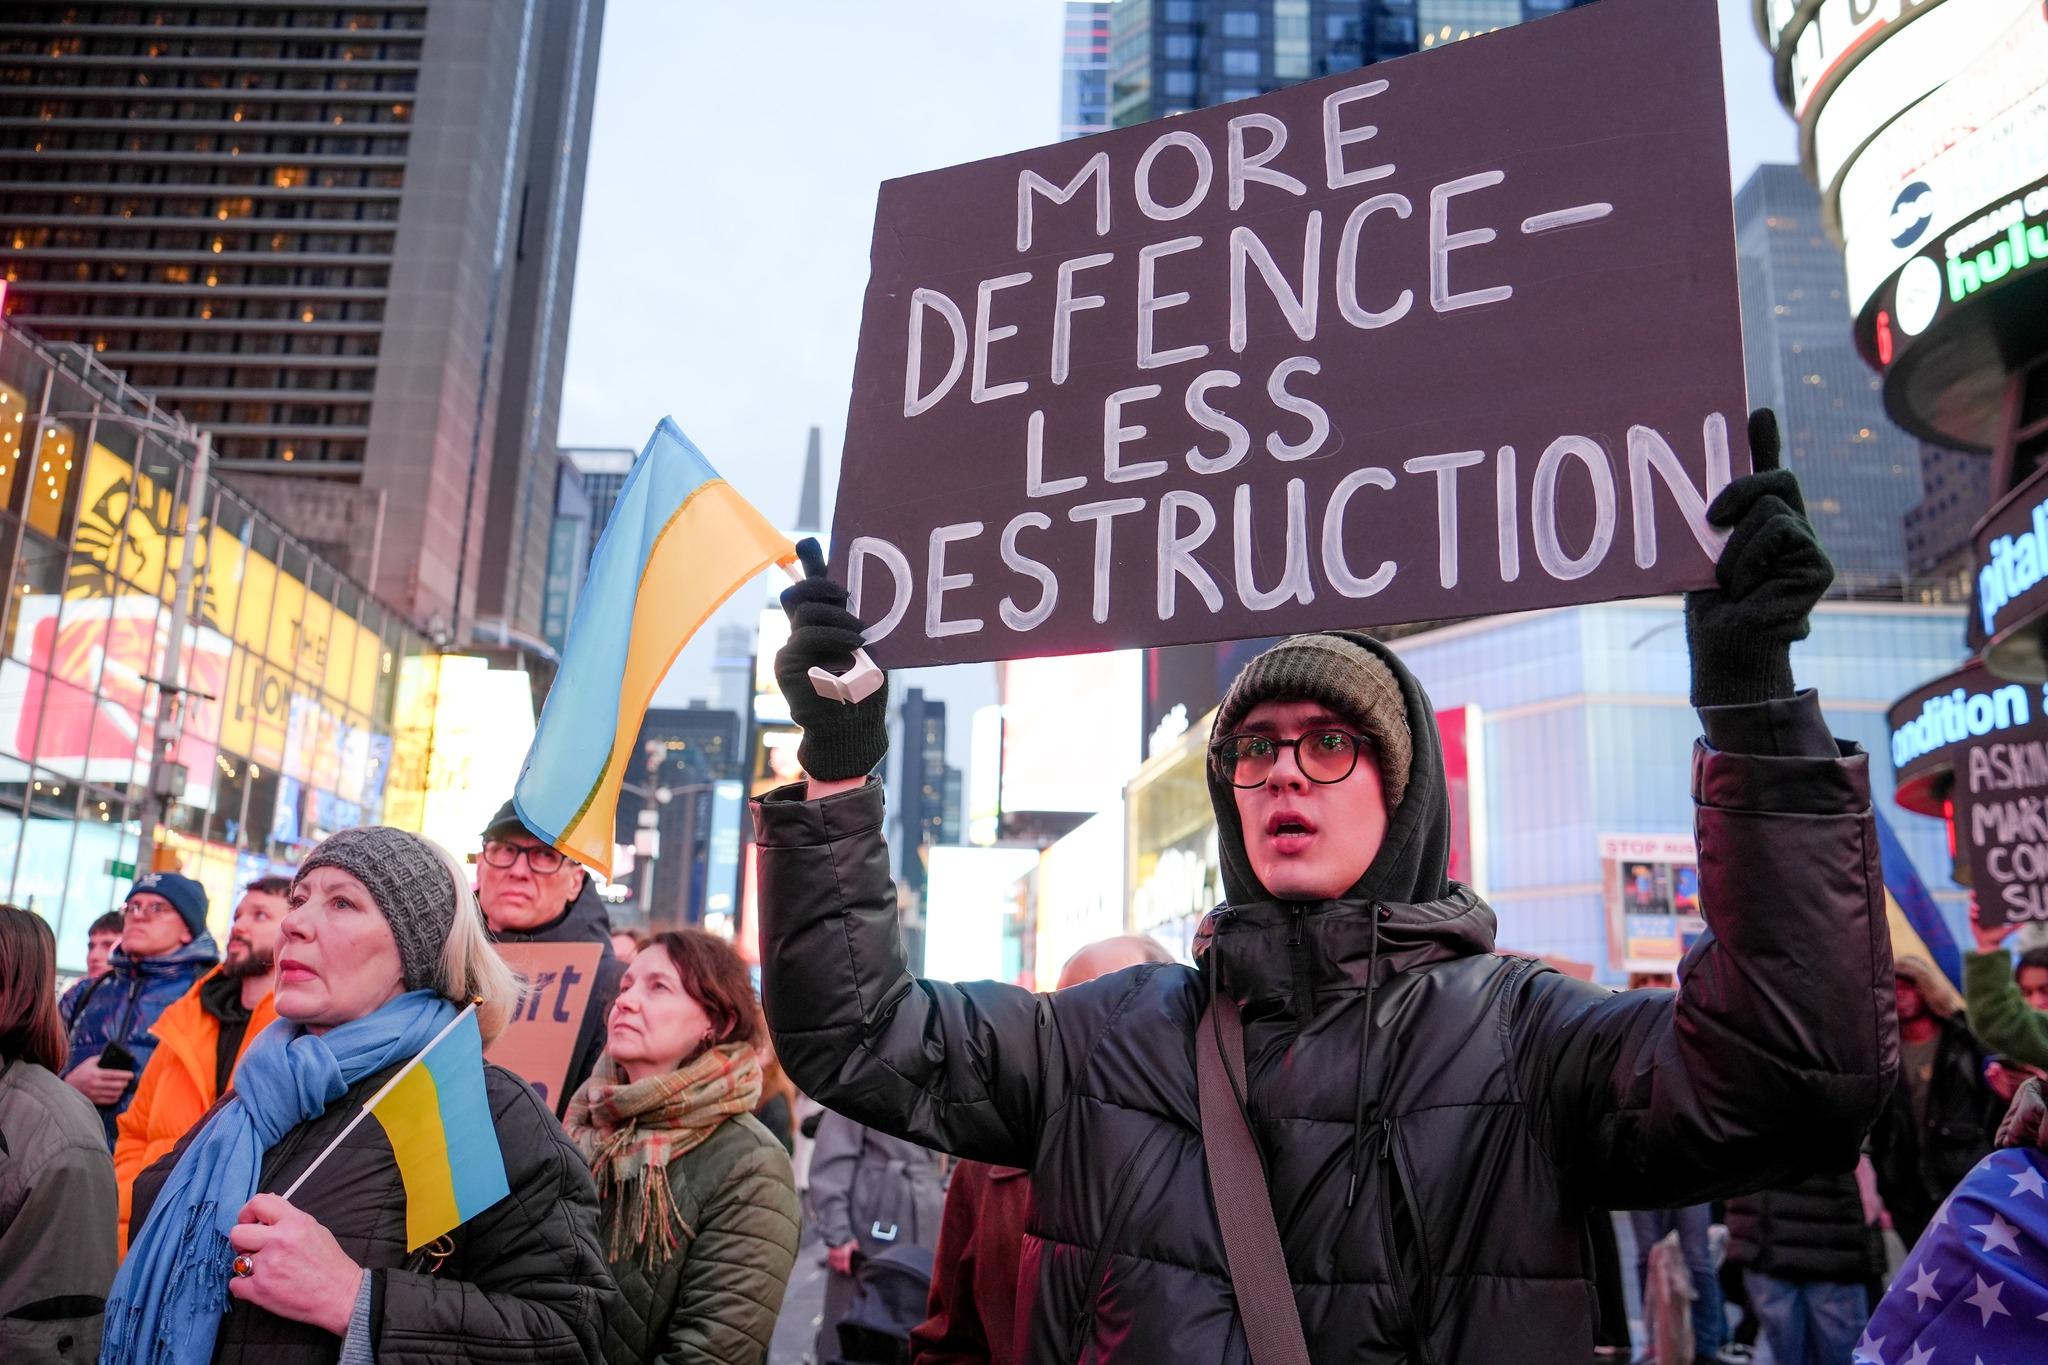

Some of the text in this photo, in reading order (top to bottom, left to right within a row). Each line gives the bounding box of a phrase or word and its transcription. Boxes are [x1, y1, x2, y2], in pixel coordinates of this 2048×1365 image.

[1016, 79, 1396, 252] MORE
[1026, 355, 1330, 498] LESS
[846, 412, 1735, 647] DESTRUCTION
[1971, 795, 2048, 846] MAK
